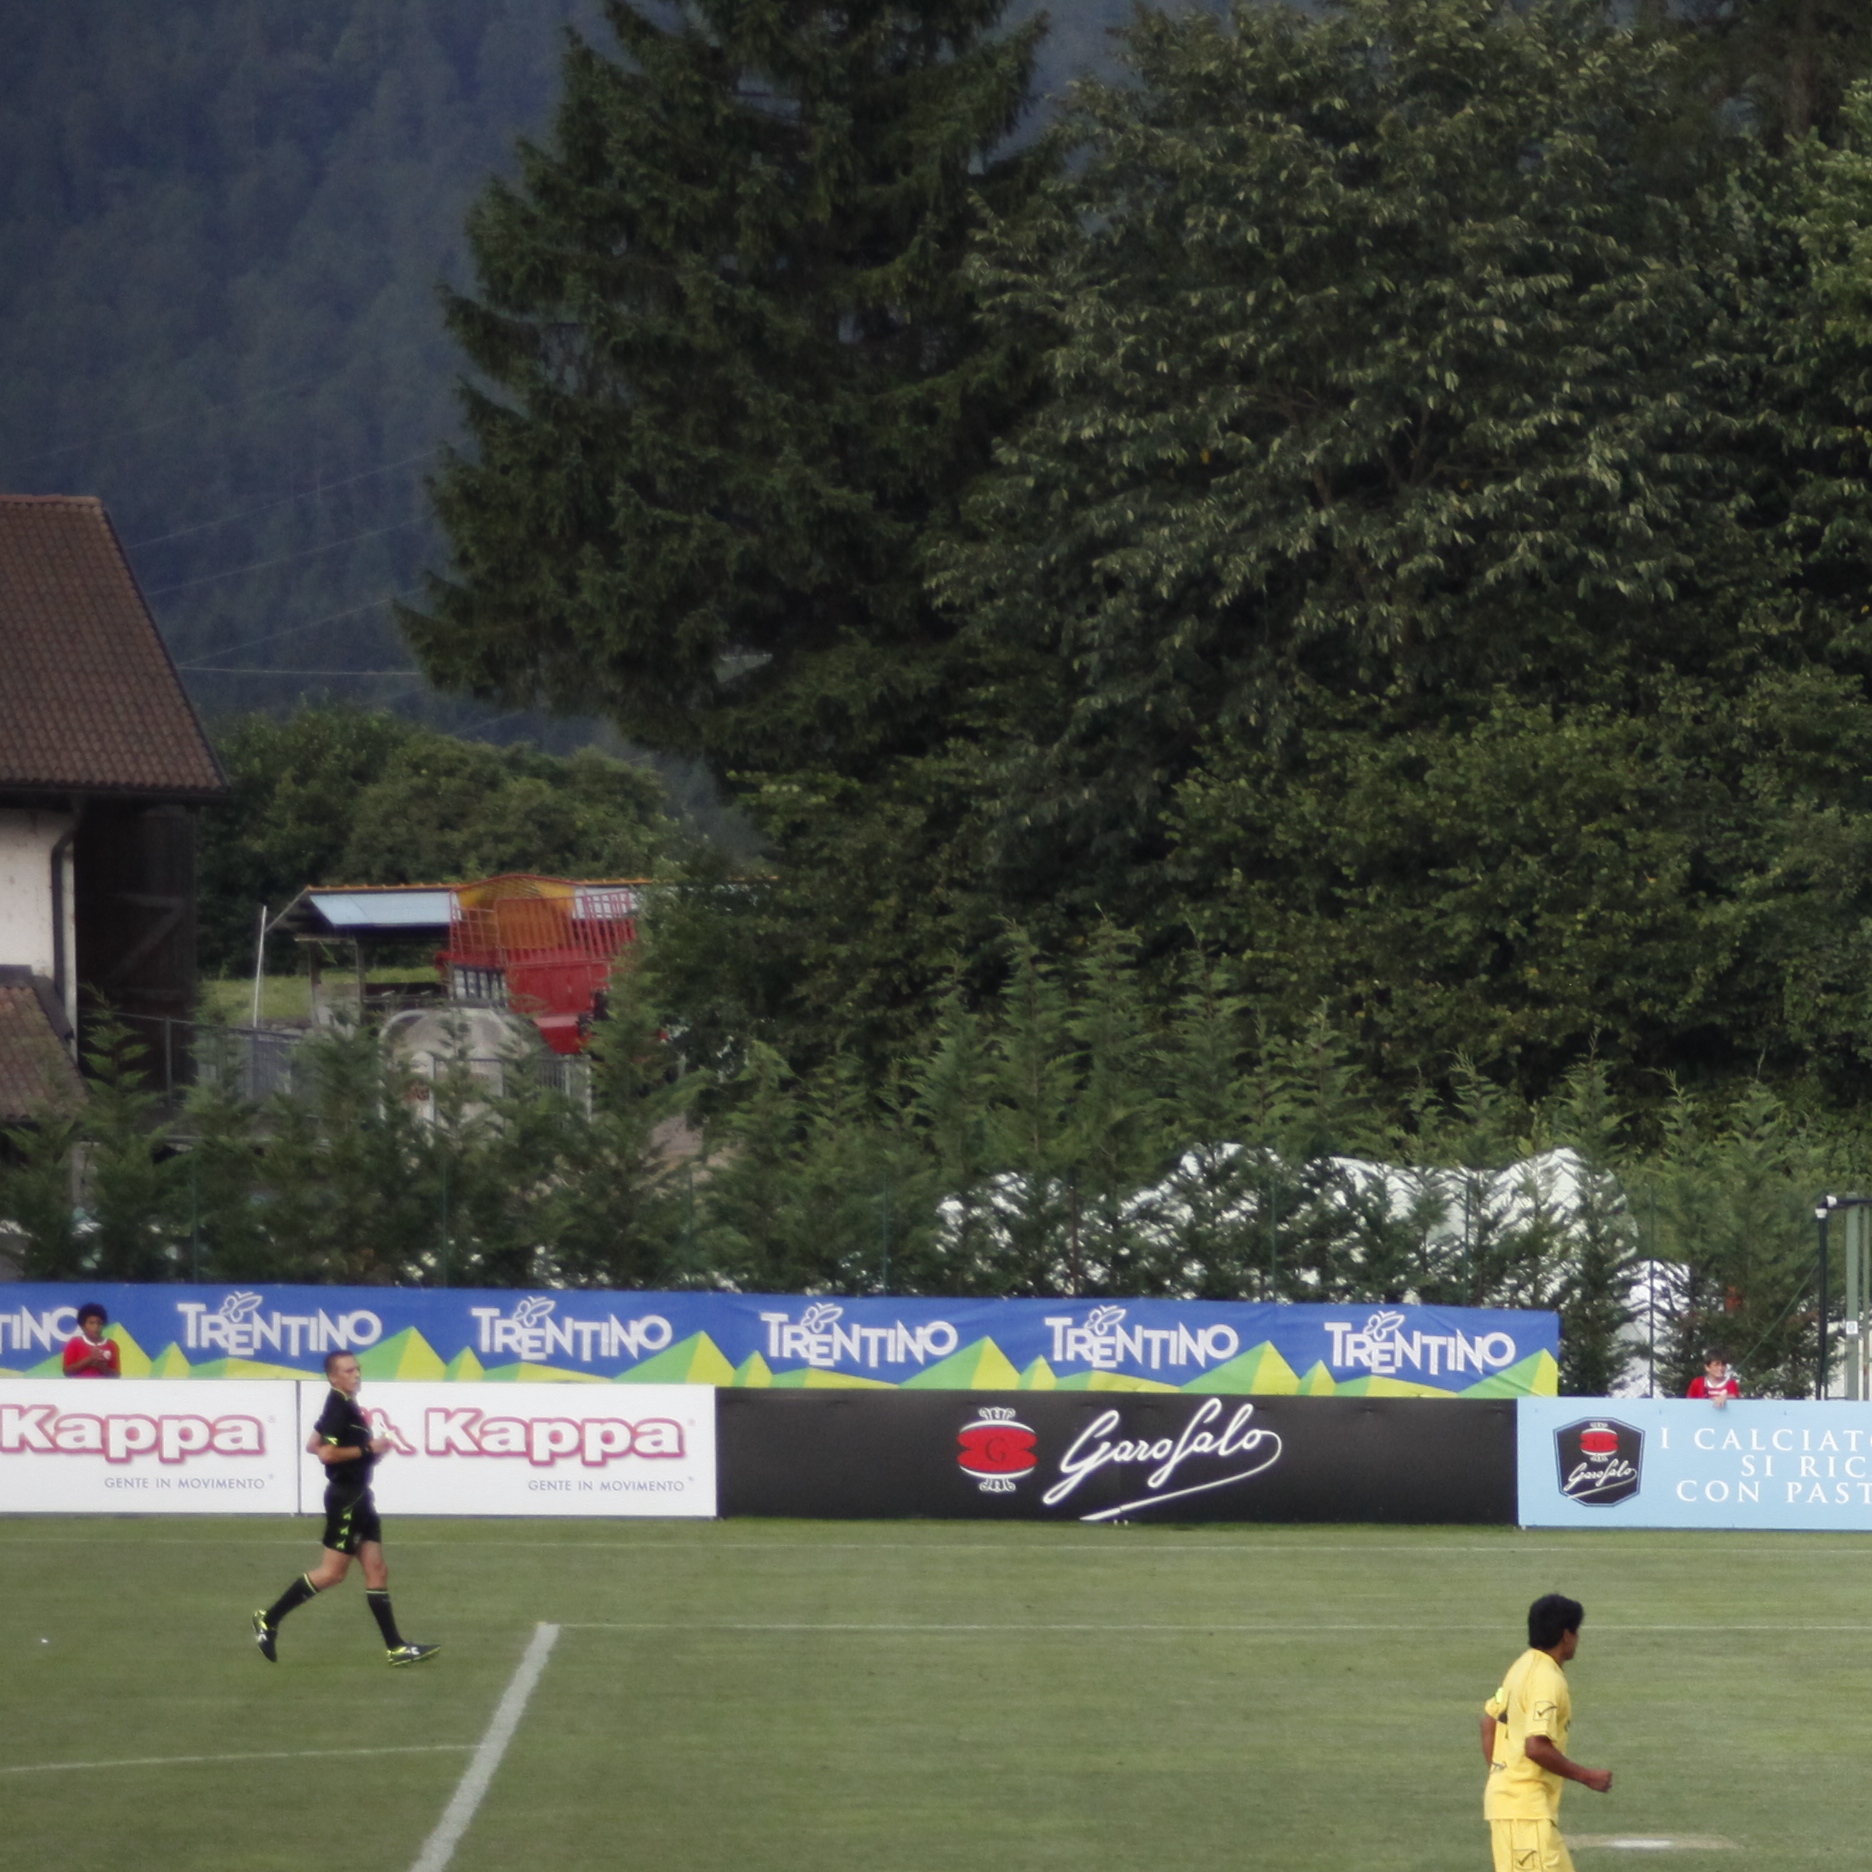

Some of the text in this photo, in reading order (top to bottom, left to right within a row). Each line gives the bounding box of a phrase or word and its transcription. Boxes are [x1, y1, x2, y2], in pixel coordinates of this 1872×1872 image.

[177, 1302, 383, 1357] TRENTINO
[471, 1307, 673, 1362] TRENTINO
[760, 1312, 958, 1368] TRENTINO
[1044, 1316, 1239, 1369] TRENTINO
[1324, 1322, 1516, 1375] TRENTINO
[0, 1404, 266, 1463] Kappa
[425, 1407, 685, 1466] Kappa
[1043, 1398, 1281, 1506] Garofalo
[1660, 1426, 1670, 1450] I
[104, 1476, 265, 1490] GENTE IN MOVIMENTO
[528, 1480, 685, 1493] GENTE IN MOVIMENTO
[1563, 1458, 1637, 1498] Garofalo
[1676, 1480, 1761, 1503] CON
[1741, 1455, 1774, 1478] SI
